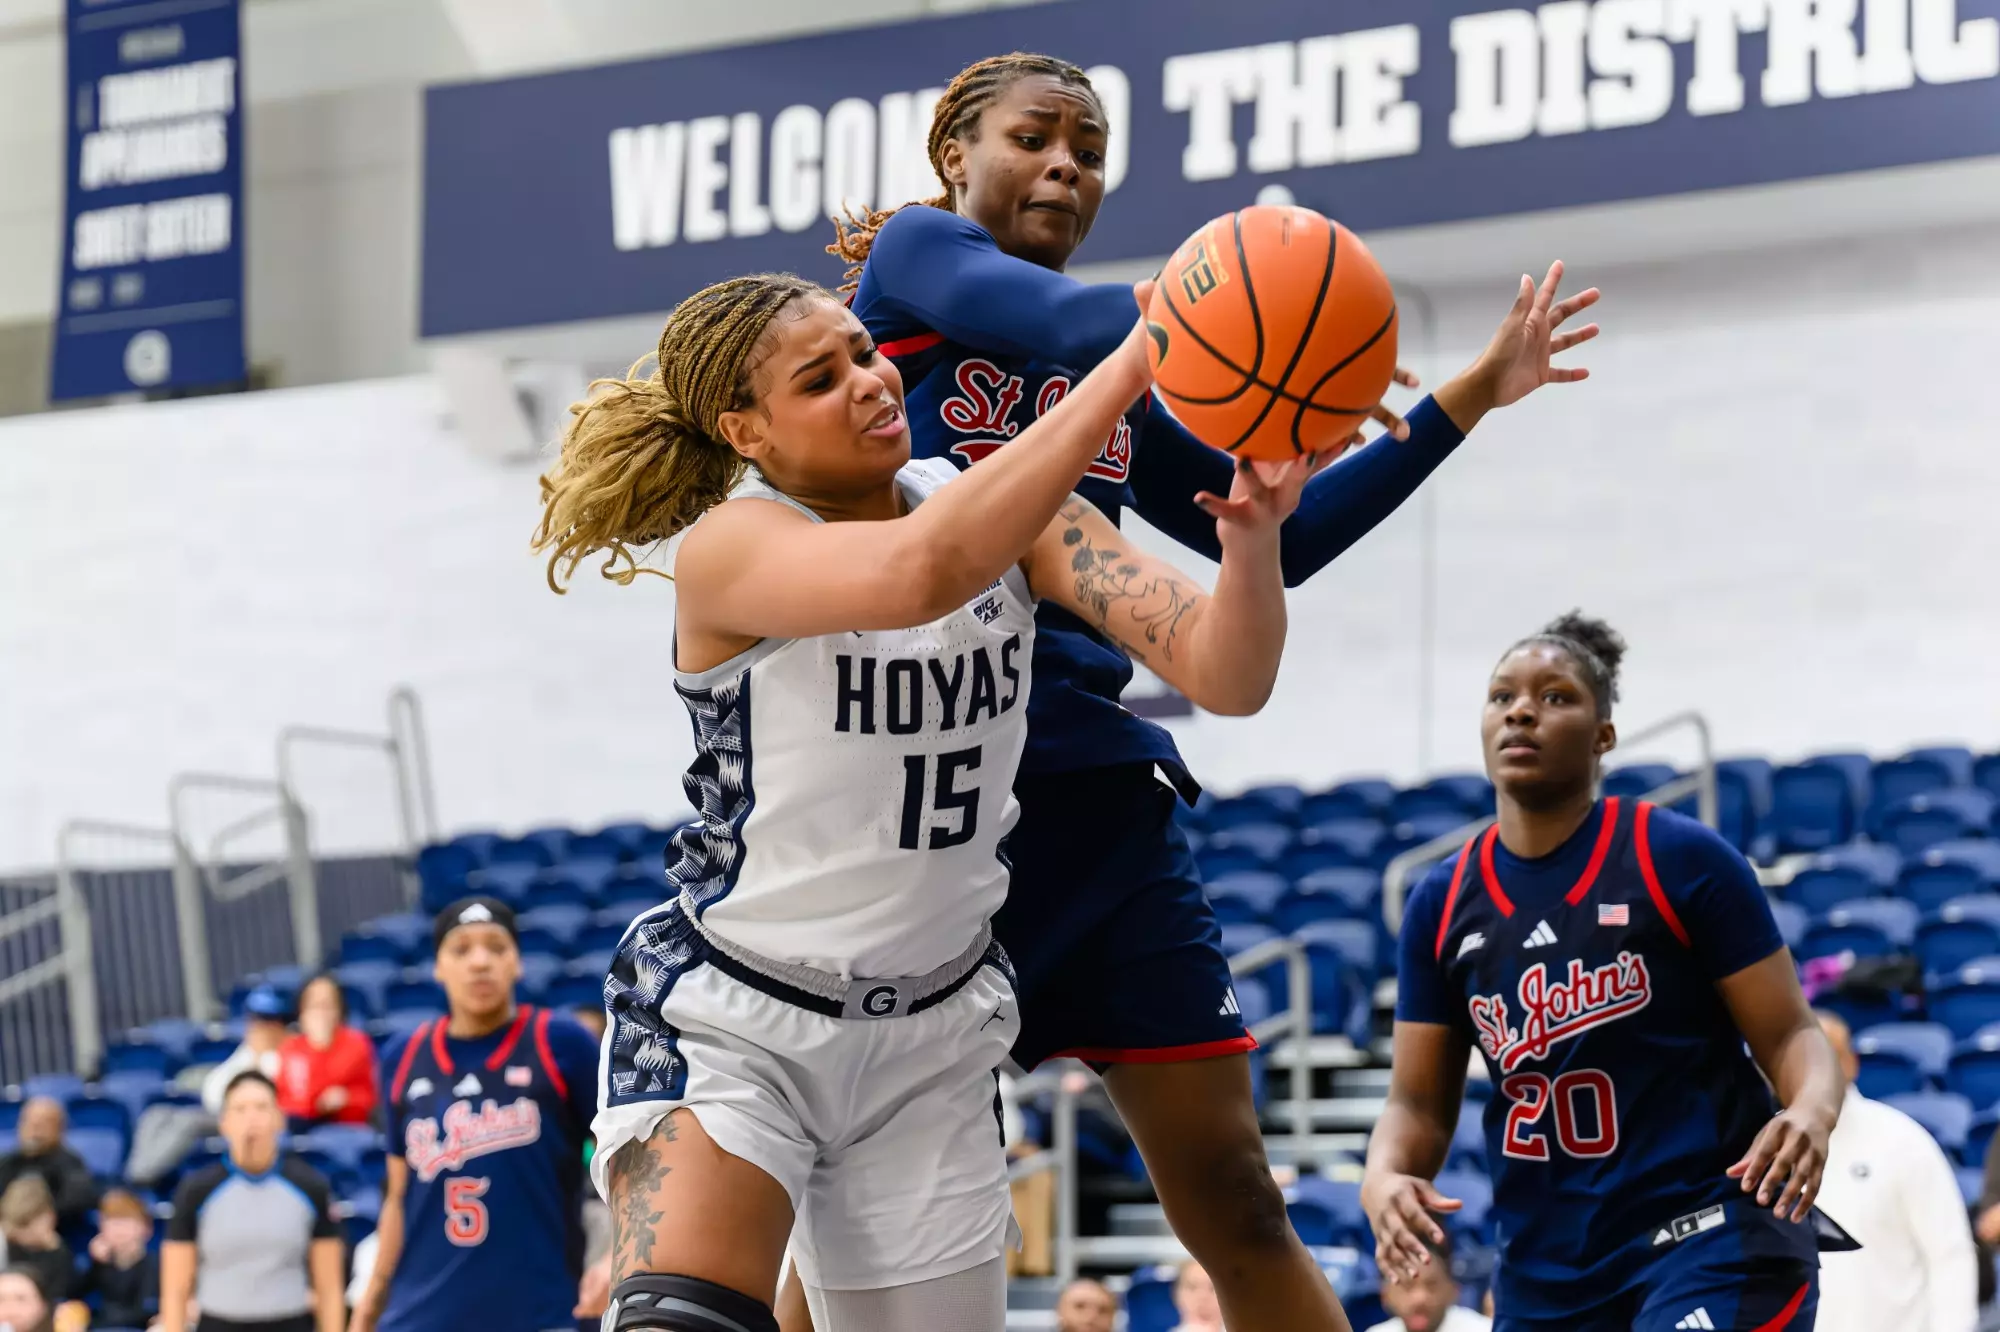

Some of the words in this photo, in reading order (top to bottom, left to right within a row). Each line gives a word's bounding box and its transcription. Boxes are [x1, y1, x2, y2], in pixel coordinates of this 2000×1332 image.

[608, 87, 945, 252] WELCOM
[1163, 24, 1421, 181] THE
[940, 358, 1025, 437] St.
[973, 596, 996, 618] BIG
[835, 633, 1021, 735] HOYAS
[899, 744, 982, 850] 15
[861, 984, 899, 1018] G
[1469, 994, 1518, 1060] St.
[1501, 950, 1652, 1073] John's
[1502, 1068, 1619, 1161] 20
[444, 1176, 491, 1247] 5
